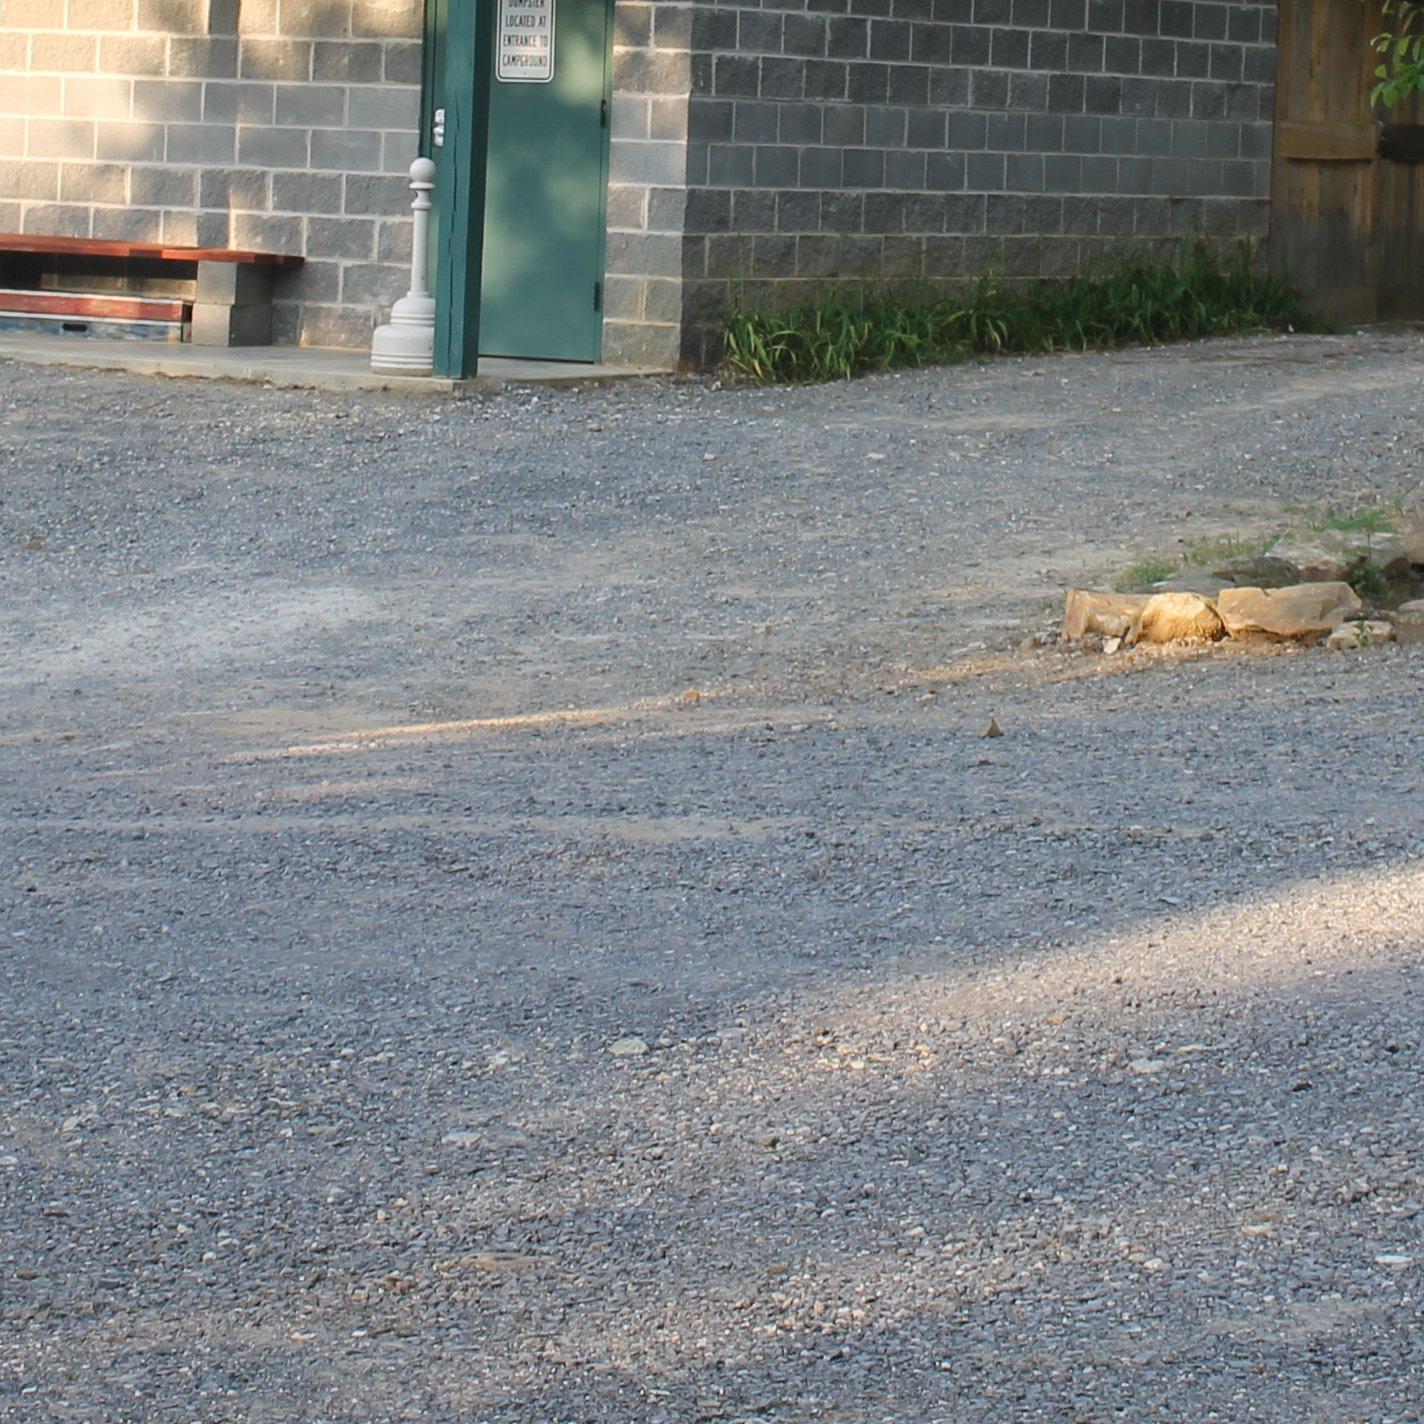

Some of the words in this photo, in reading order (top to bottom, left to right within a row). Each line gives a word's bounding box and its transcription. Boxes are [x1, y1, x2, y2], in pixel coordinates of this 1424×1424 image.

[506, 15, 535, 27] LOCATED
[538, 15, 547, 27] AT
[503, 35, 536, 47] ENTRANCE
[539, 35, 548, 48] TO
[502, 55, 548, 67] CAMPGROUND
